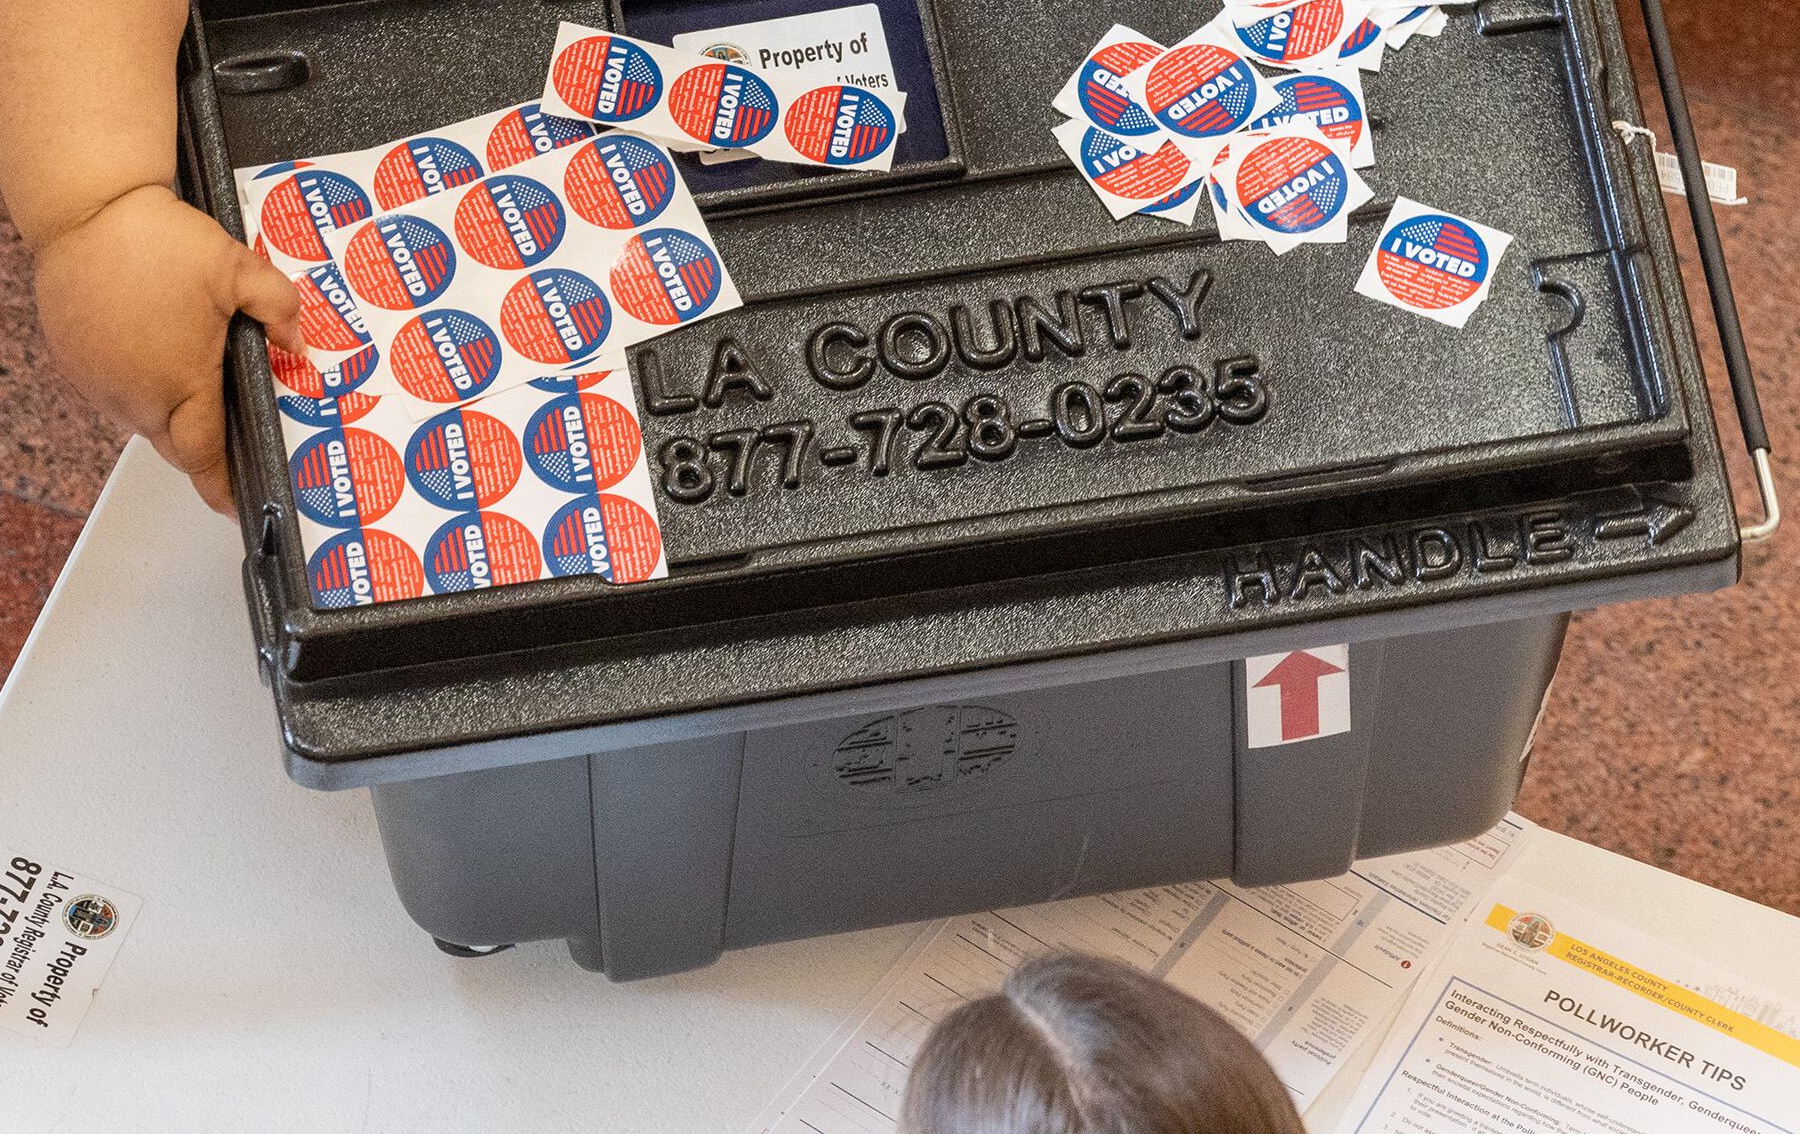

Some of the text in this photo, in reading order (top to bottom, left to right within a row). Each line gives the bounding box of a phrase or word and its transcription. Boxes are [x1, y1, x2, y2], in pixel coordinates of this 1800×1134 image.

[759, 33, 869, 69] Property of
[1229, 67, 1242, 80] I
[601, 57, 626, 114] VOTED
[1092, 68, 1132, 100] TED
[1168, 75, 1234, 120] VOTED
[525, 112, 540, 122] I
[714, 85, 741, 139] VOTED
[831, 105, 857, 158] VOTED
[413, 146, 445, 194] I VOT
[600, 144, 617, 154] I
[1093, 160, 1105, 173] I
[1320, 160, 1335, 175] I
[301, 178, 317, 187] I
[491, 185, 508, 193] I
[604, 156, 645, 216] VOTED
[1258, 169, 1326, 213] VOTED
[380, 224, 396, 232] I
[495, 196, 536, 256] VOTED
[384, 236, 426, 297] VOTED
[645, 238, 691, 311] I VOTED
[1391, 241, 1476, 278] I VOTED
[311, 267, 325, 279] I
[321, 277, 368, 334] VOTED
[537, 278, 583, 350] I VOTED
[426, 318, 472, 392] I VOTED
[636, 268, 1212, 416] LA COUNTY
[320, 408, 338, 417] I
[658, 354, 1269, 505] 877-728-0235
[445, 423, 474, 499] I VOTED
[564, 406, 592, 482] I VOTED
[327, 441, 356, 517] I VOTED
[465, 525, 491, 587] VOTED
[583, 507, 610, 580] VOTED
[1229, 508, 1573, 611] HANDLE
[347, 542, 373, 605] VOTED
[24, 890, 62, 924] County
[47, 871, 74, 891] L.A.
[3, 928, 44, 974] Registrar
[1374, 944, 1400, 961] Affidavit
[1570, 944, 1667, 991] LOS ANGELES COUNTY
[3, 971, 19, 988] of
[26, 941, 88, 1028] Property of
[1566, 952, 1704, 1017] REGISTRAR-RECORDER/COUNTY
[1706, 1016, 1734, 1032] CLERK
[1291, 1040, 1331, 1065] Political party
[1304, 1041, 1336, 1059] preference
[1436, 1015, 1479, 1040] Definitions:
[1445, 1000, 1658, 1105] Gender Non-Conforming (GNC) People
[1544, 990, 1746, 1090] POLLWORKER TIPS
[1451, 990, 1759, 1134] Interacting Respectfully with Transgender, Genderquee
[1401, 1070, 1445, 1094] Respectful
[1446, 1091, 1490, 1115] Interaction
[1502, 1117, 1514, 1127] the
